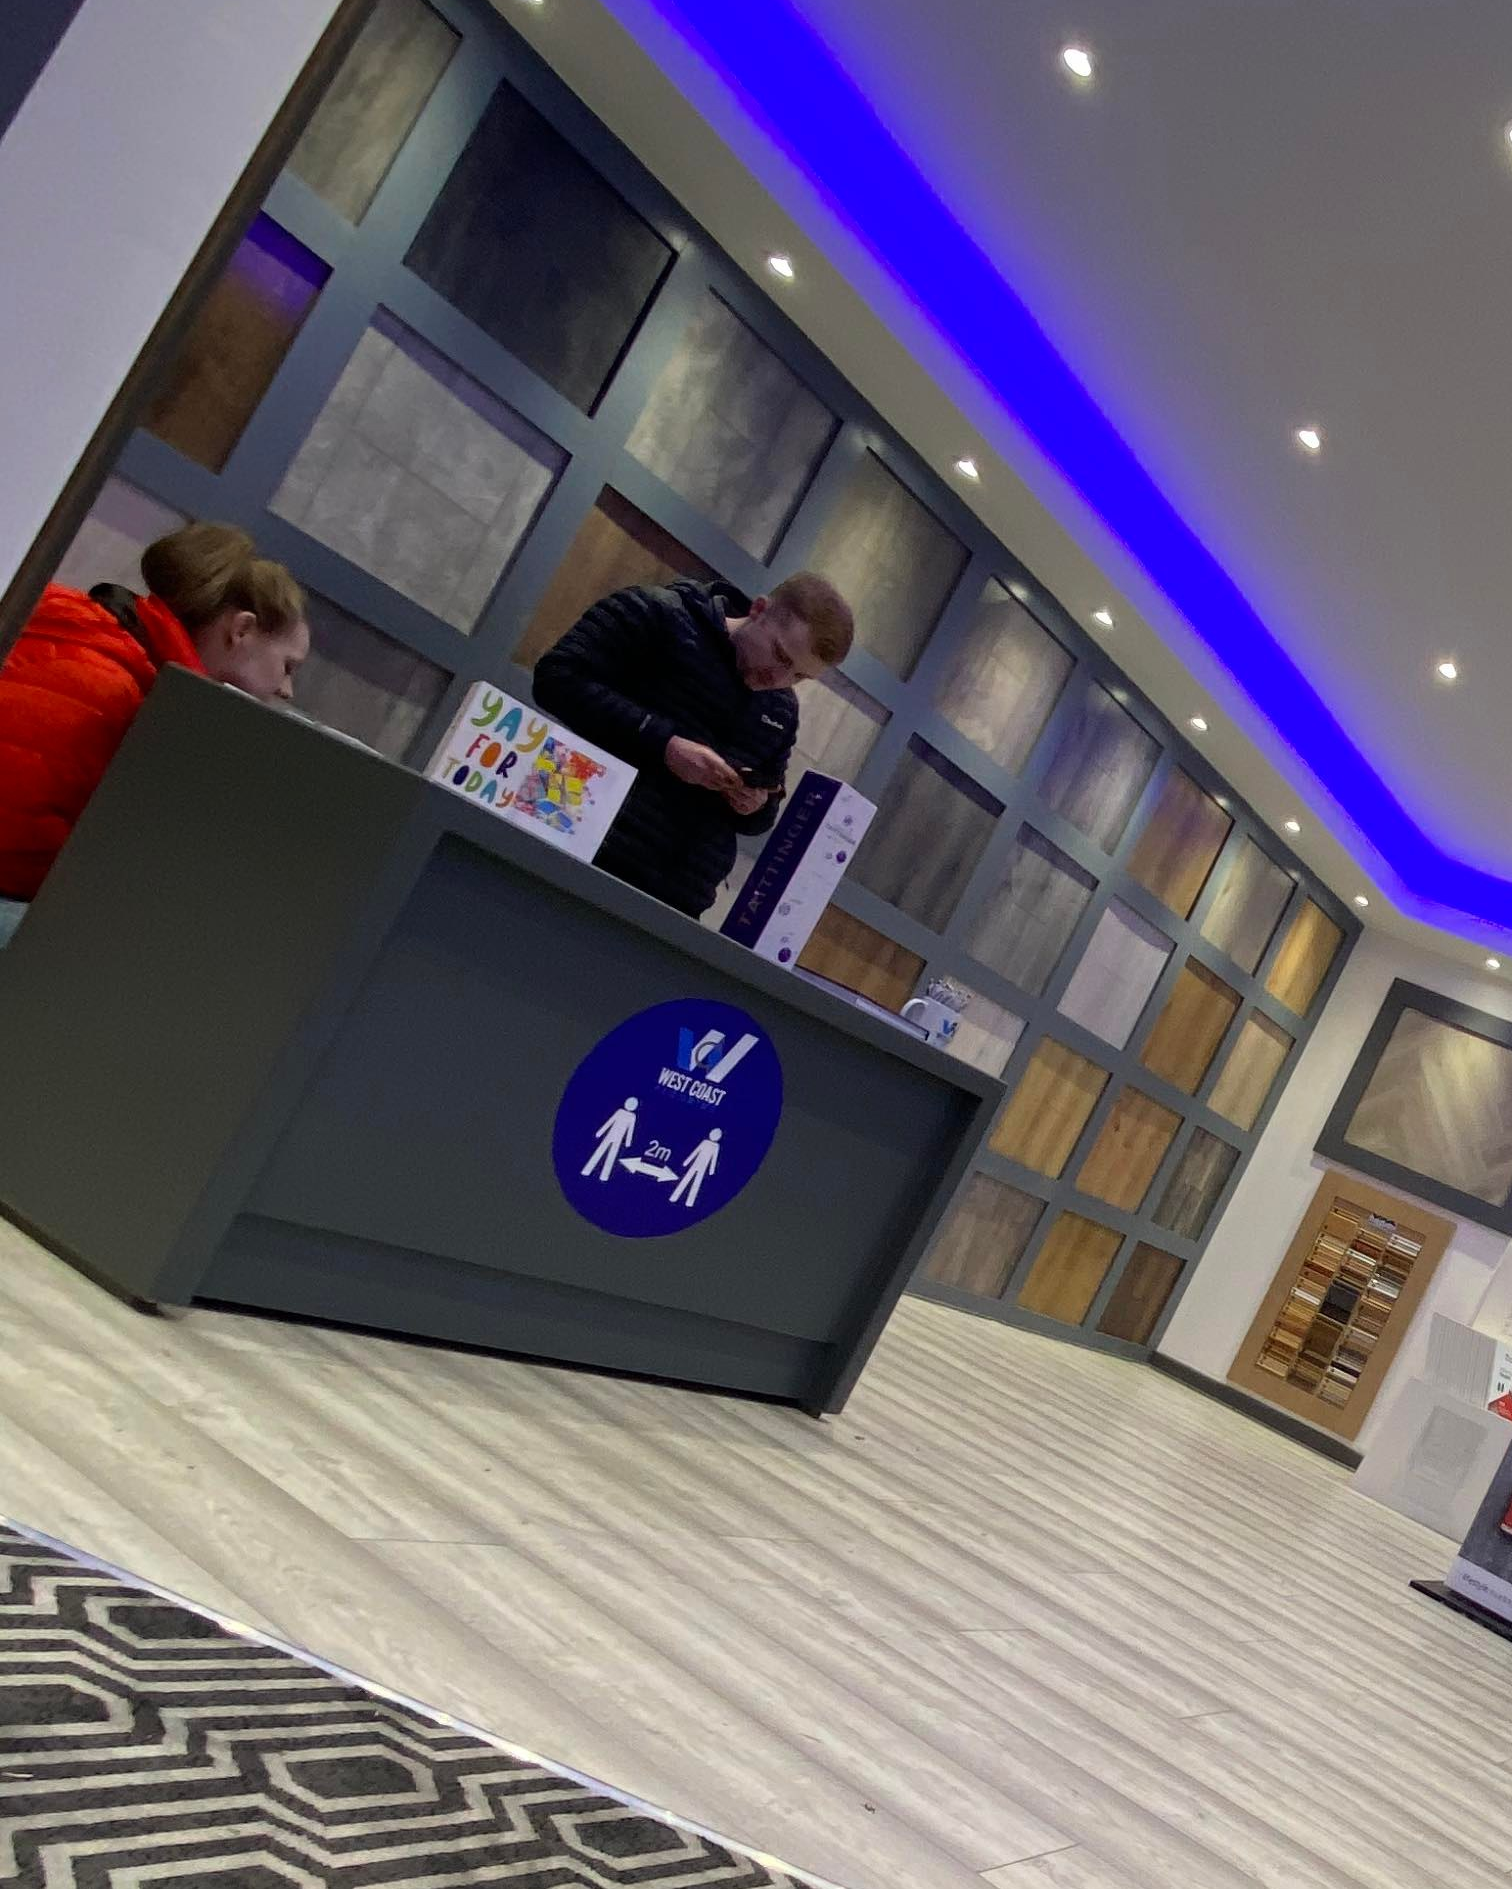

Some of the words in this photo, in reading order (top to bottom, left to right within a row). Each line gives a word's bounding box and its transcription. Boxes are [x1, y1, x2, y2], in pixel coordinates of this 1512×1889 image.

[470, 690, 548, 753] YAY
[465, 733, 518, 778] FOR
[442, 758, 516, 809] TODAY
[738, 790, 823, 927] TAITTINGER
[658, 1067, 693, 1092] WEST
[689, 1080, 727, 1106] COAST
[644, 1139, 672, 1162] 2m
